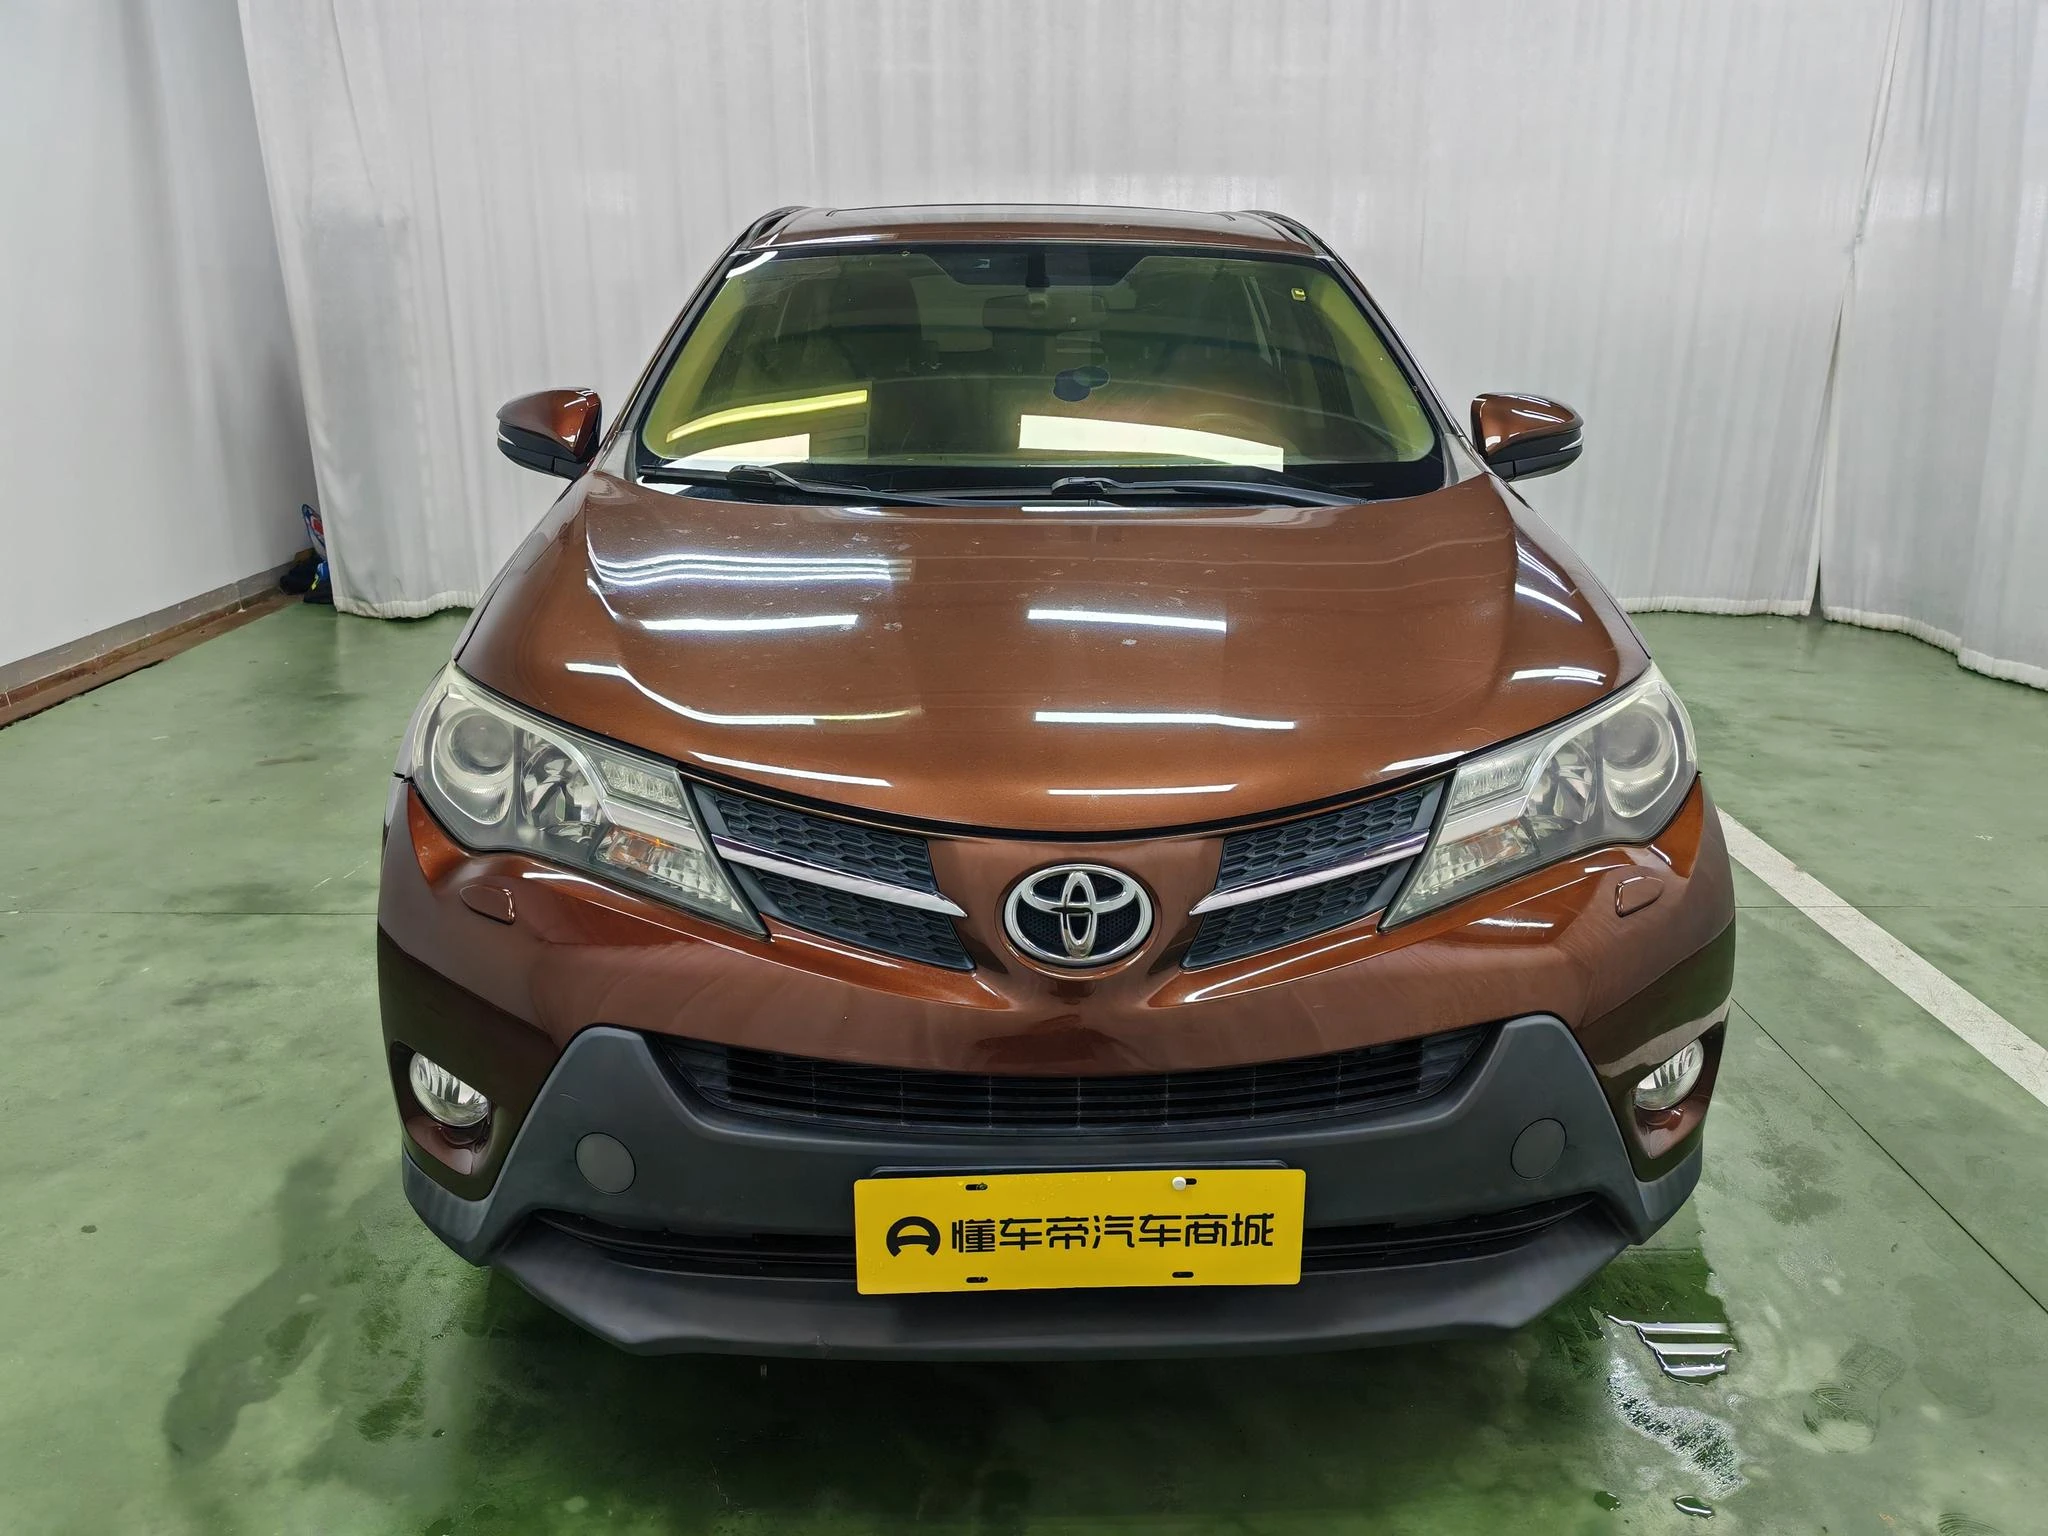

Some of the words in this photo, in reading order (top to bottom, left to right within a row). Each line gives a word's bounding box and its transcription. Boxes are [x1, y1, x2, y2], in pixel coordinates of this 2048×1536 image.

[951, 1212, 1275, 1253] 懂车帝汽车商城
